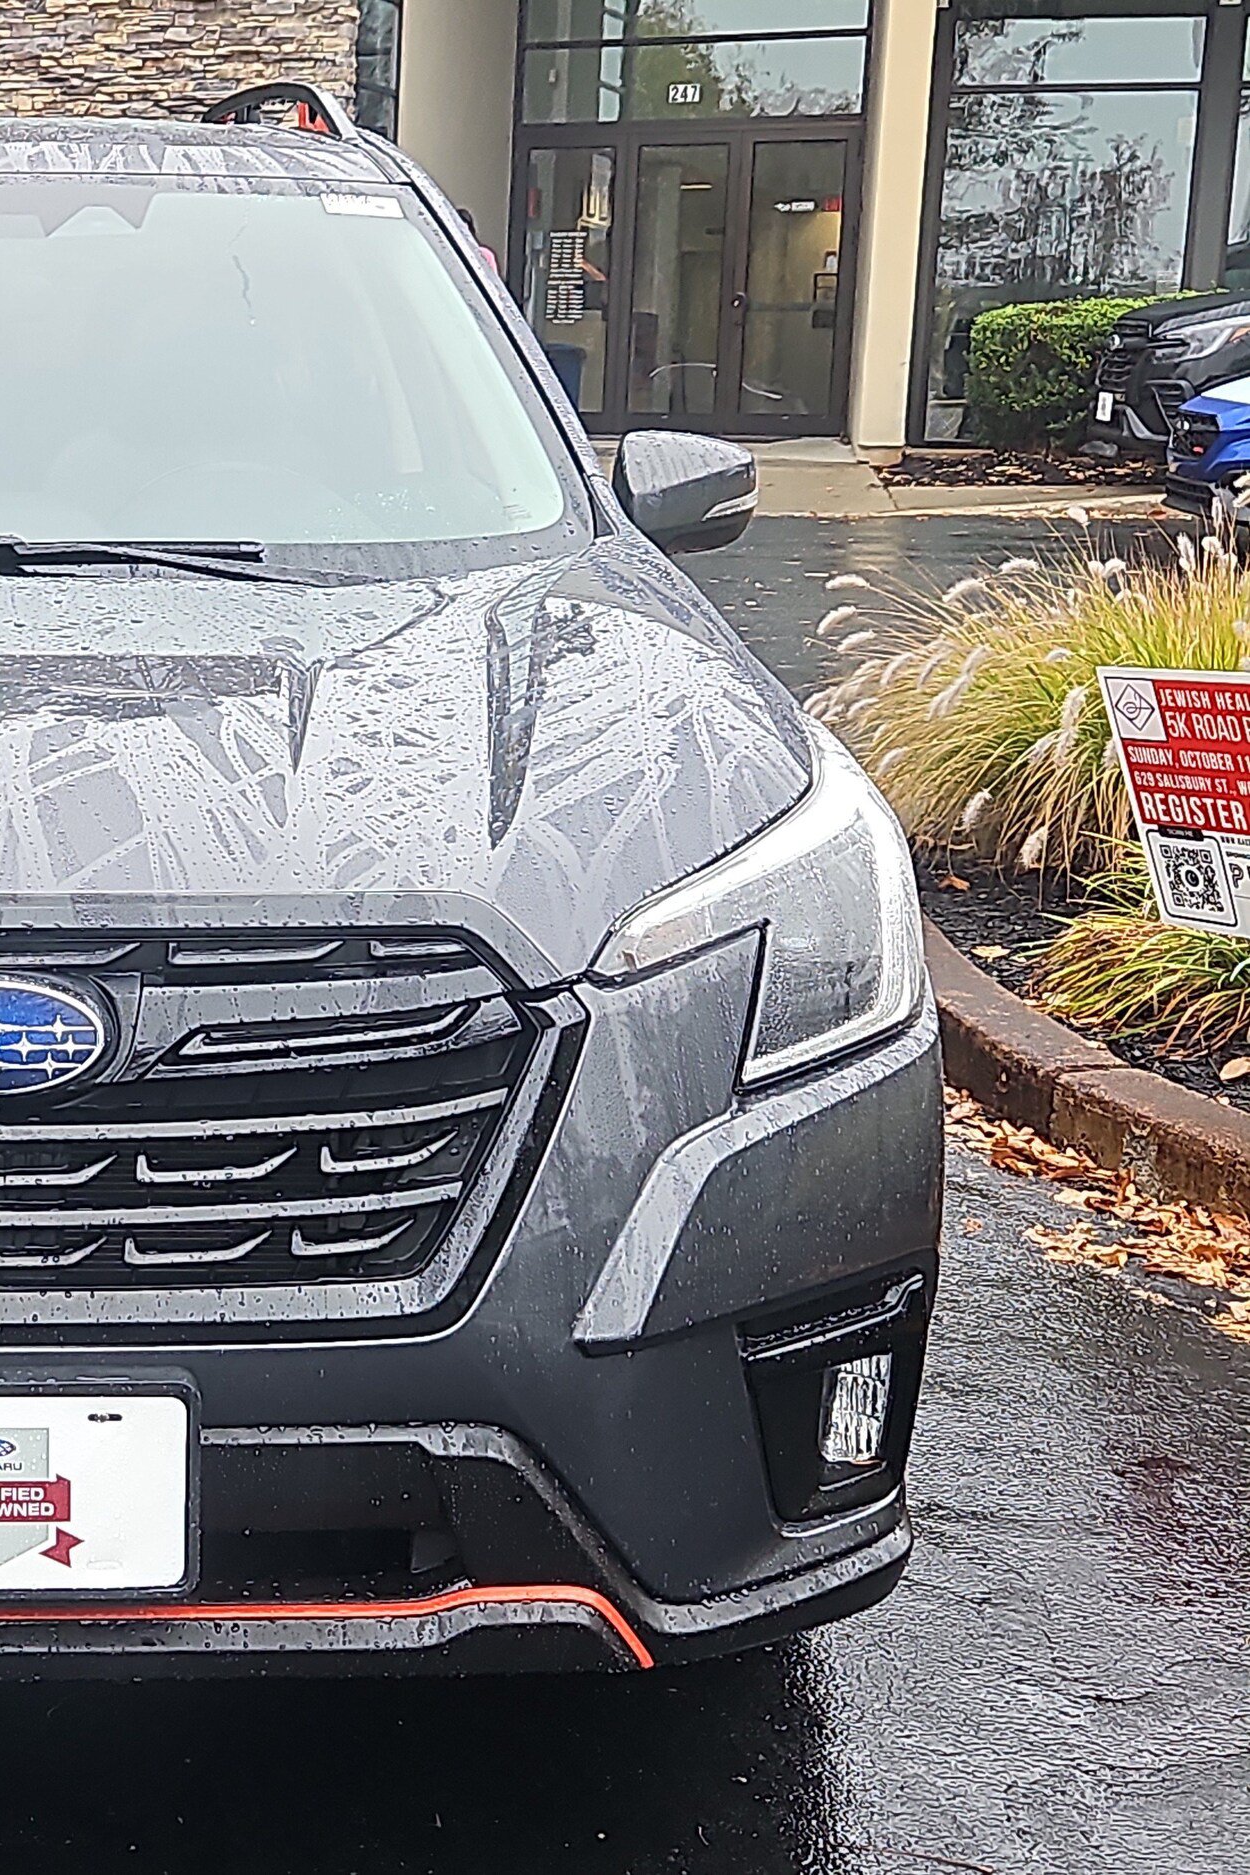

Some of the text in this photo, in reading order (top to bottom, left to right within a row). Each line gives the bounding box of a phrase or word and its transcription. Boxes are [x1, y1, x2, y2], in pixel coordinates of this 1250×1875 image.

[670, 85, 698, 102] 247
[1159, 688, 1212, 710] JEWISH
[1164, 711, 1192, 739] 5K
[1191, 712, 1242, 742] ROAD
[1127, 745, 1180, 769] SUNDAY,
[1179, 750, 1235, 772] OCTOBER
[1134, 770, 1156, 787] 629
[1156, 773, 1212, 792] SALISBURY
[1139, 791, 1248, 831] REGISTER
